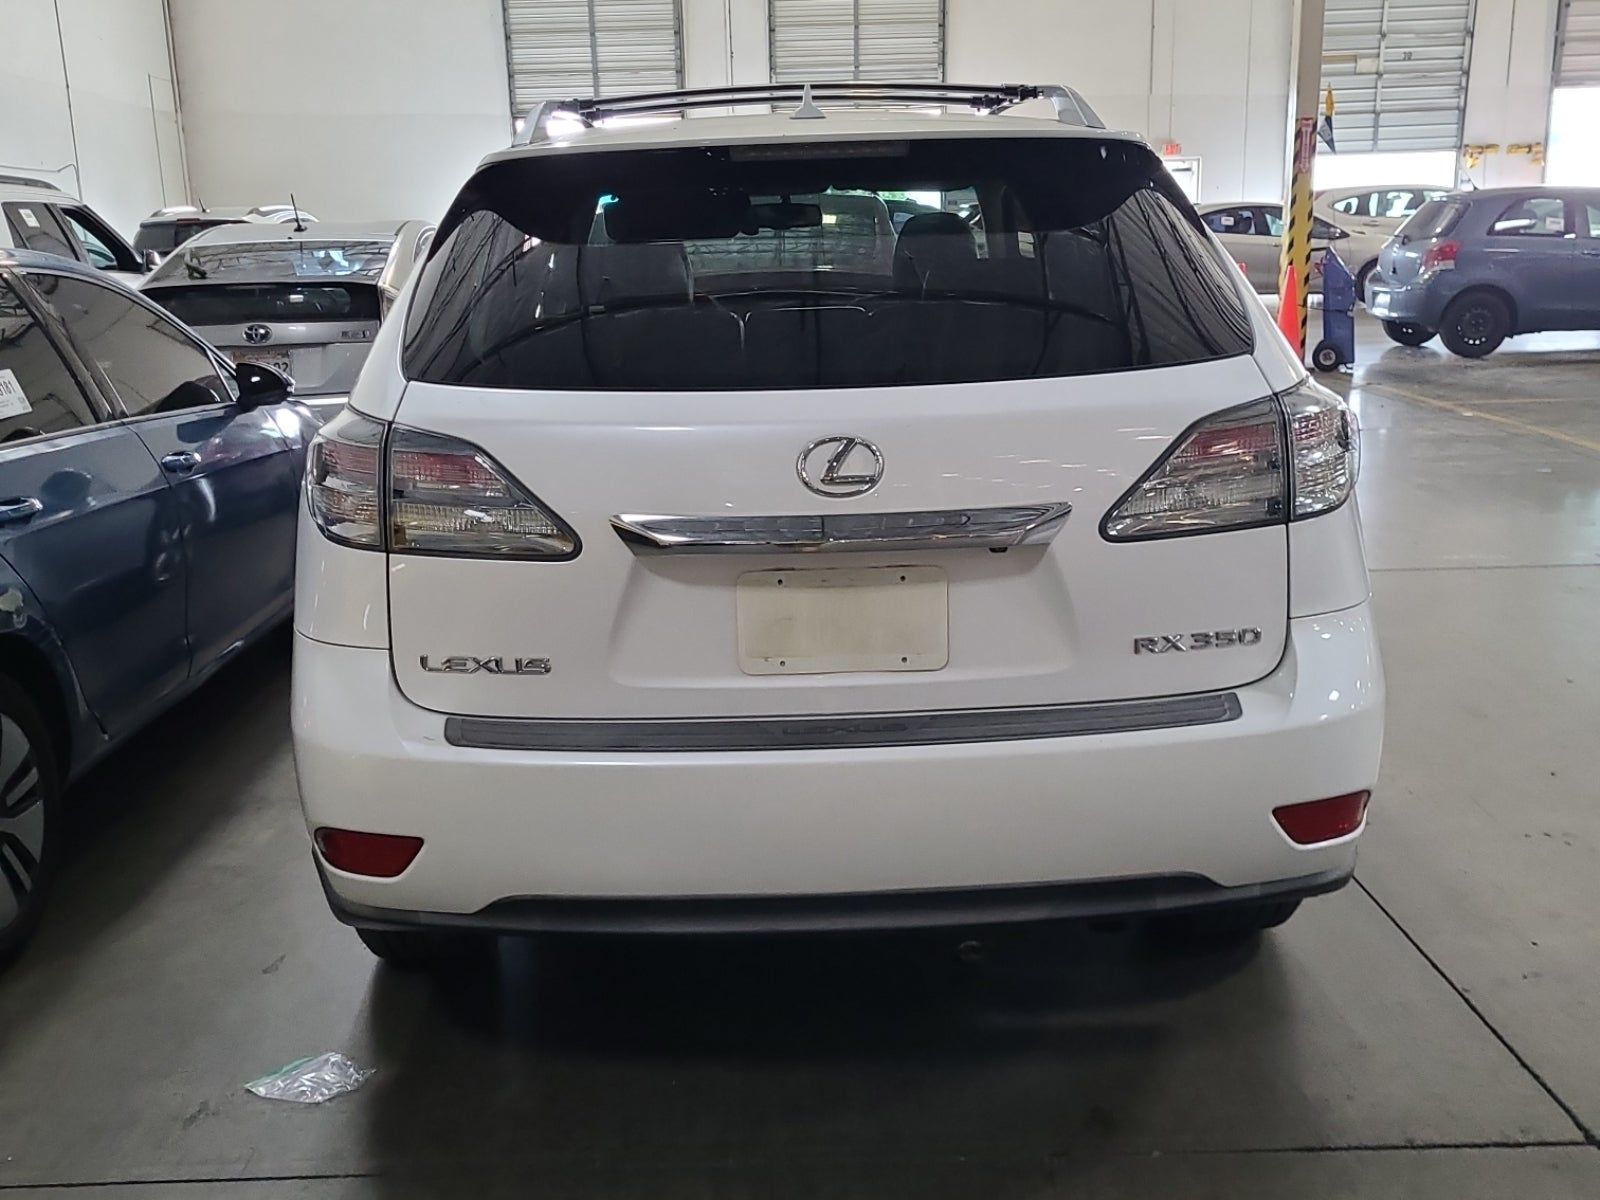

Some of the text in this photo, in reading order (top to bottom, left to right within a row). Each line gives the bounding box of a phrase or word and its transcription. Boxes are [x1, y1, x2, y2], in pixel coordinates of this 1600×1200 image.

[1133, 626, 1262, 655] RX 350
[419, 654, 552, 675] LEXUS
